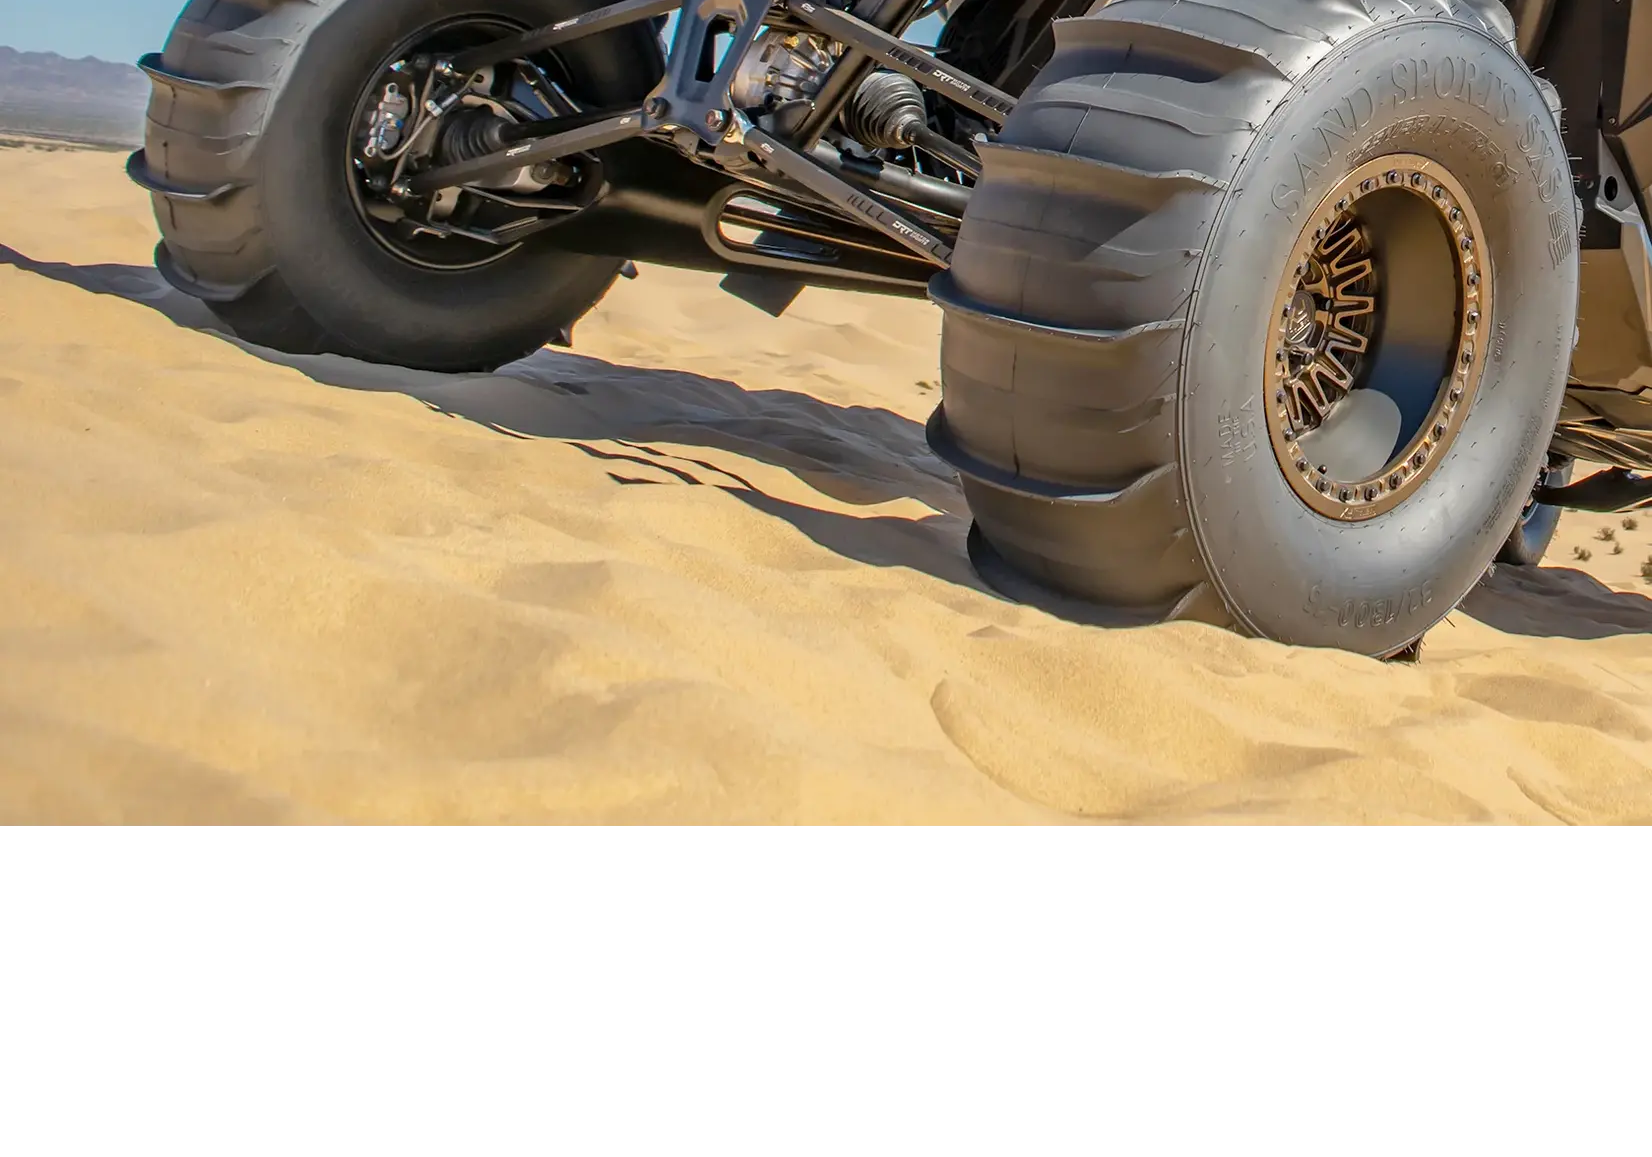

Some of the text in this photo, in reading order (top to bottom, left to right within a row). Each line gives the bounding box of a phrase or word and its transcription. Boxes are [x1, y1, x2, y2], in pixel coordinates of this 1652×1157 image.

[1270, 87, 1376, 218] SAND
[1390, 55, 1517, 125] SPORTS
[1516, 113, 1563, 204] SXS
[1218, 413, 1234, 469] MADE
